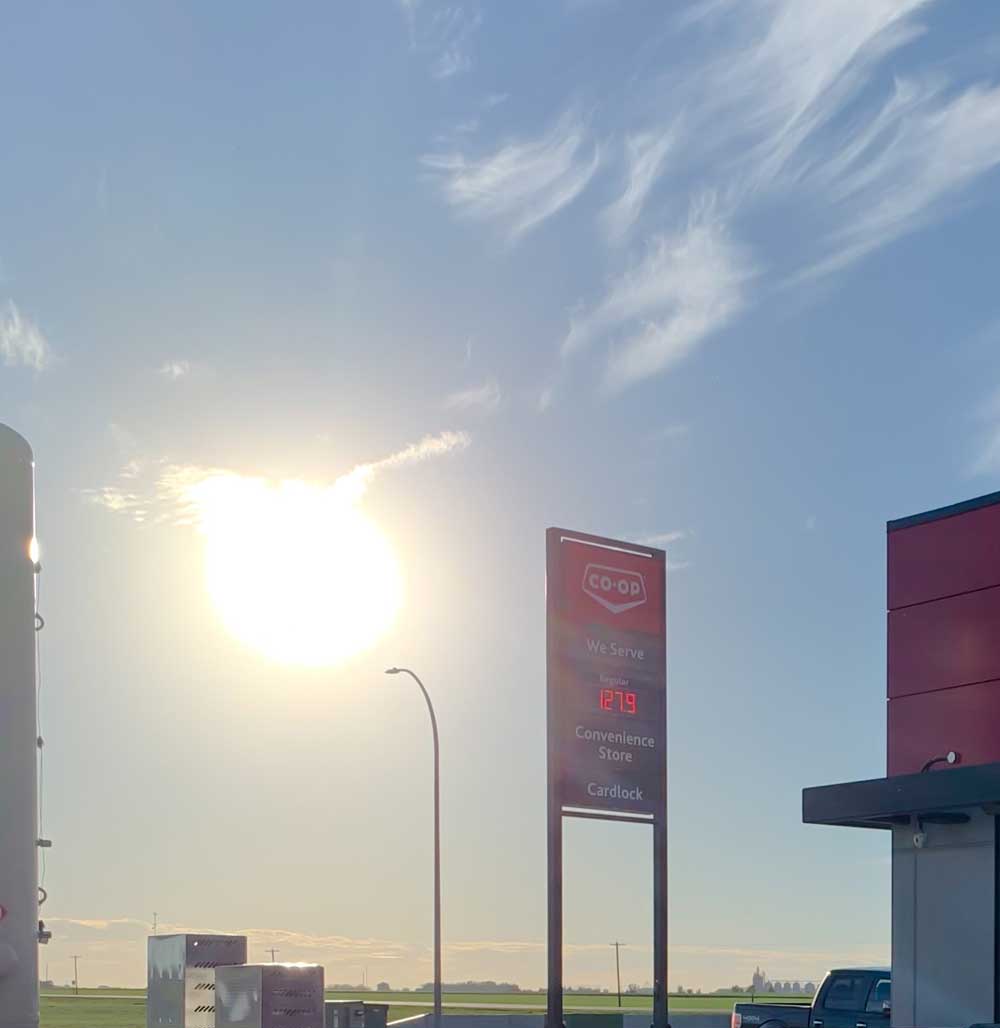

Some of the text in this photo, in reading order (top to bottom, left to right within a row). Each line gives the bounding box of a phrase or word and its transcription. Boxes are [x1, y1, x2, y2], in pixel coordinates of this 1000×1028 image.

[586, 638, 645, 660] We Serve
[575, 726, 655, 748] Convenience
[598, 746, 633, 762] Store
[587, 782, 643, 801] Cardlock
